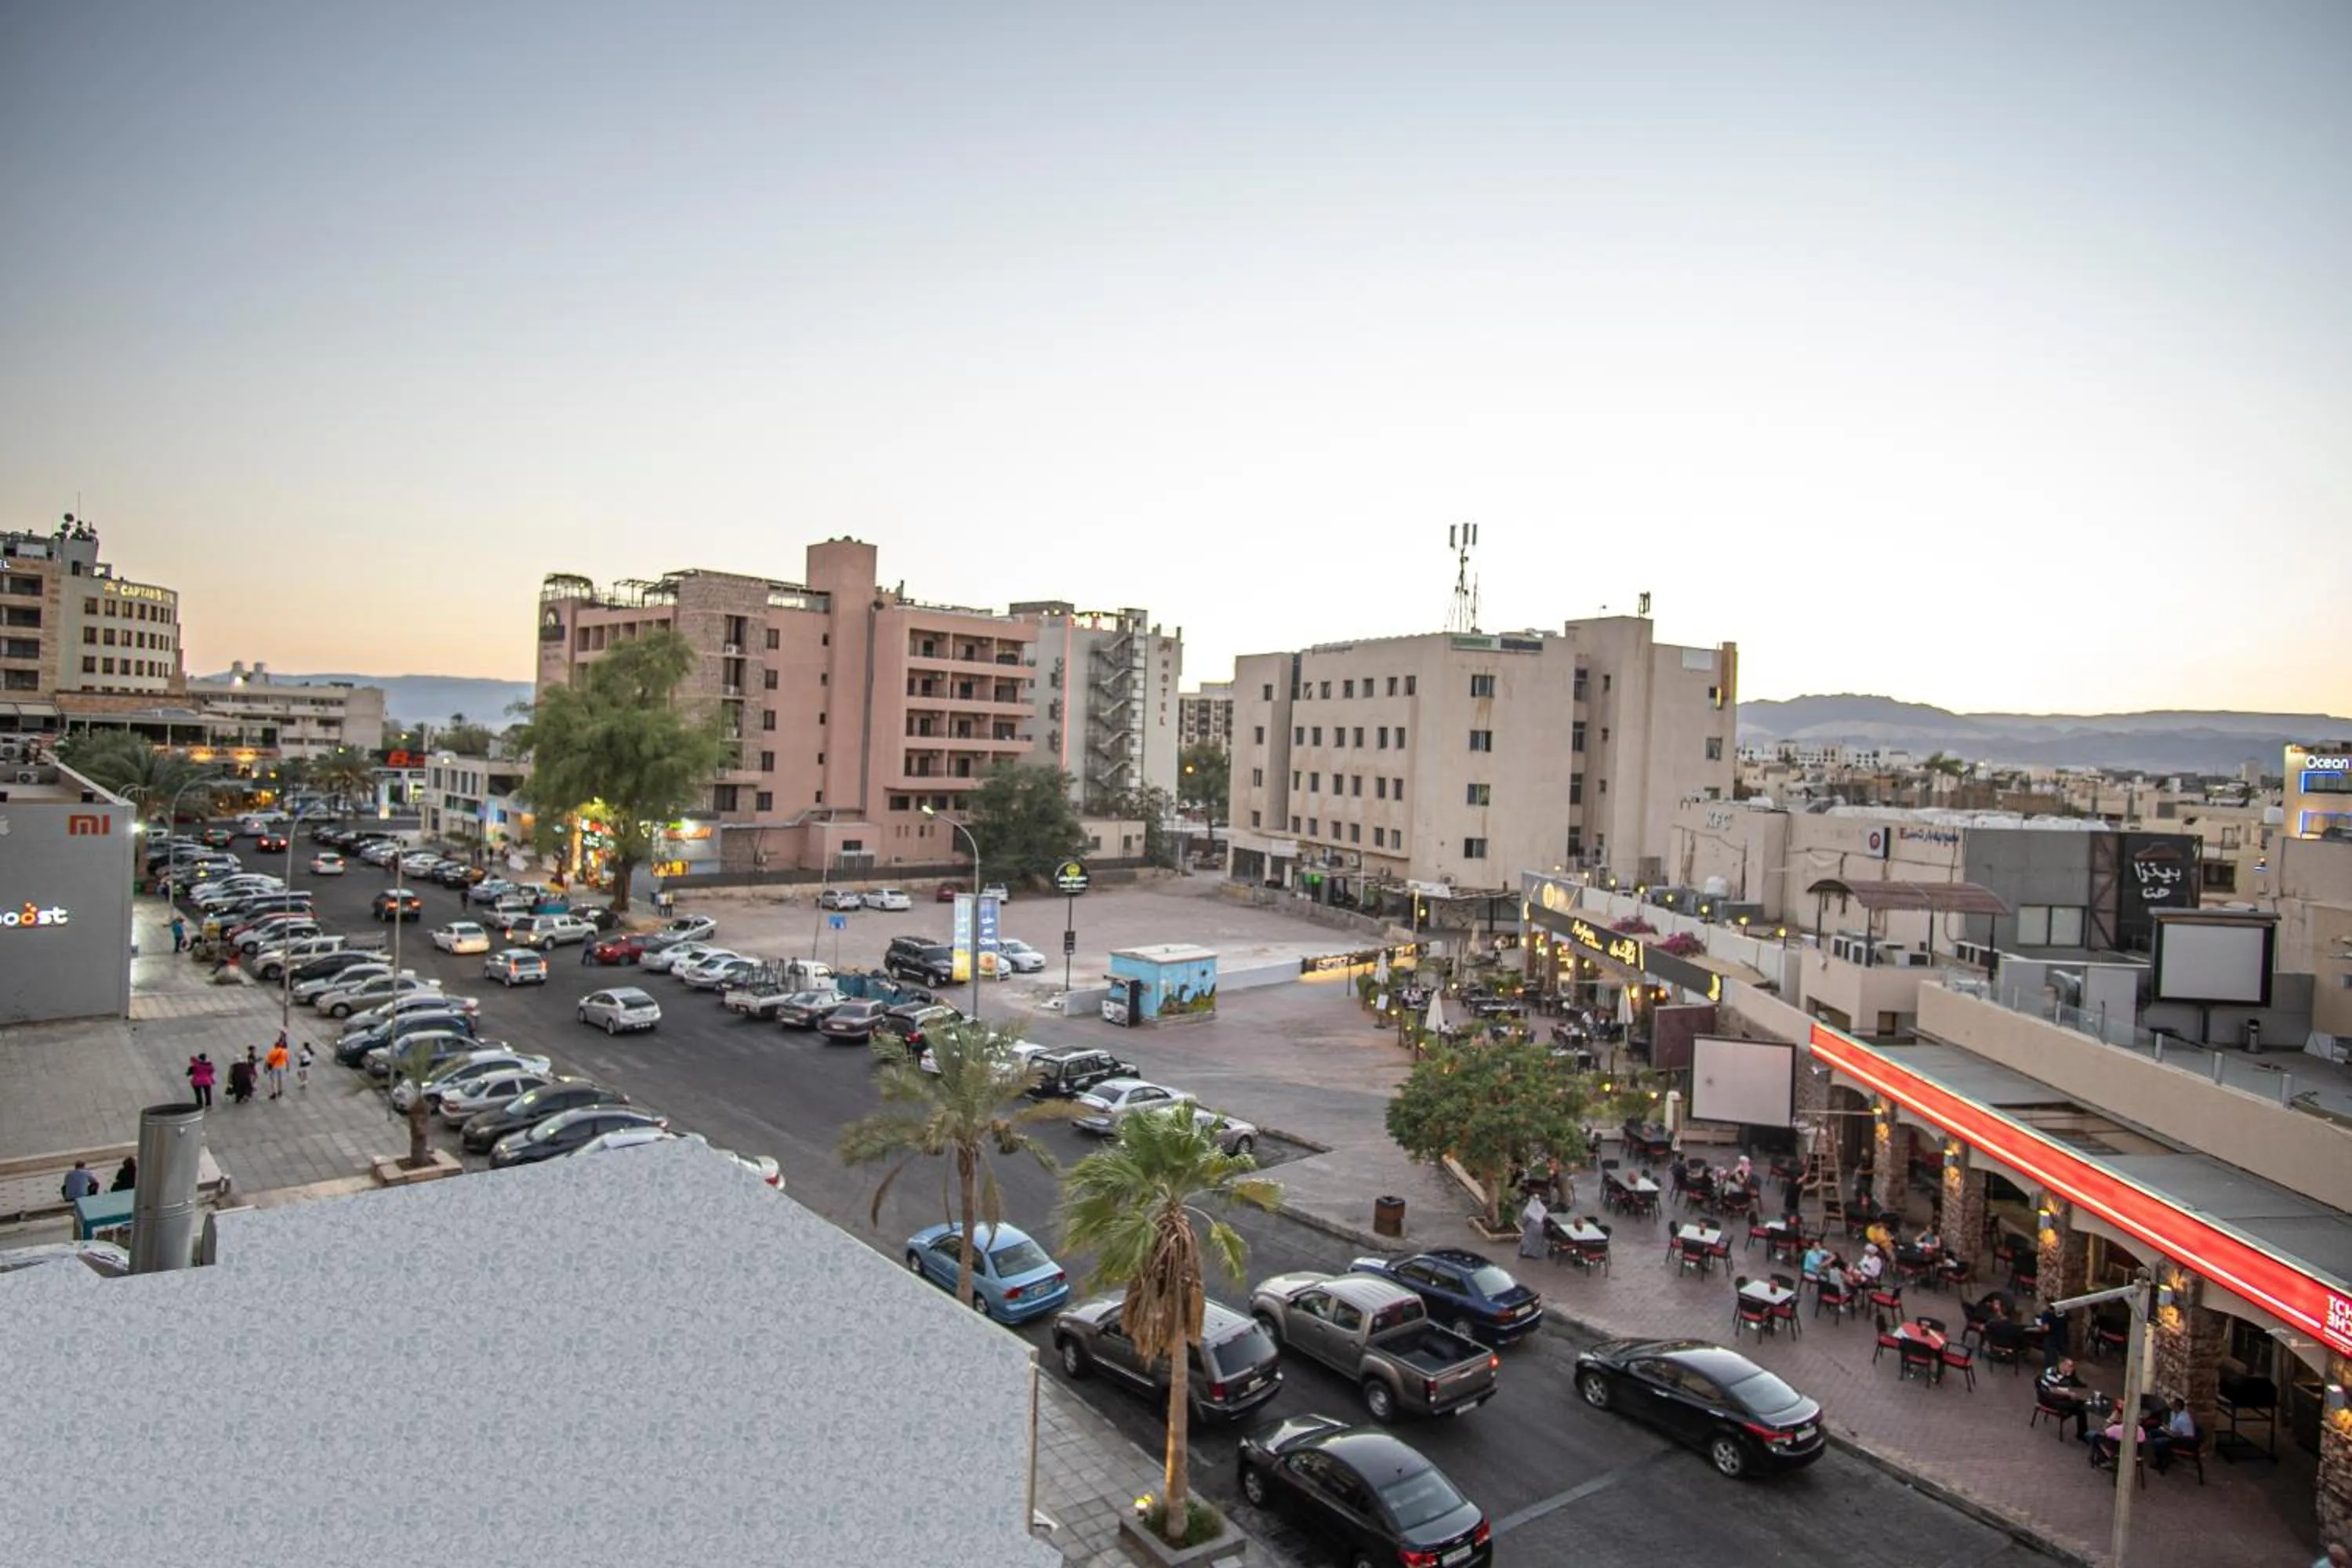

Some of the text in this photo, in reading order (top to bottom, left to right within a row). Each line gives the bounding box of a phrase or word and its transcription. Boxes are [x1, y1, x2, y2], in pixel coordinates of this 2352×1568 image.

[1160, 659, 1169, 726] HOTEL
[2307, 755, 2350, 769] Ocean
[2134, 862, 2181, 884] بيتزا
[0, 903, 68, 926] oost
[2326, 1294, 2352, 1320] TCH
